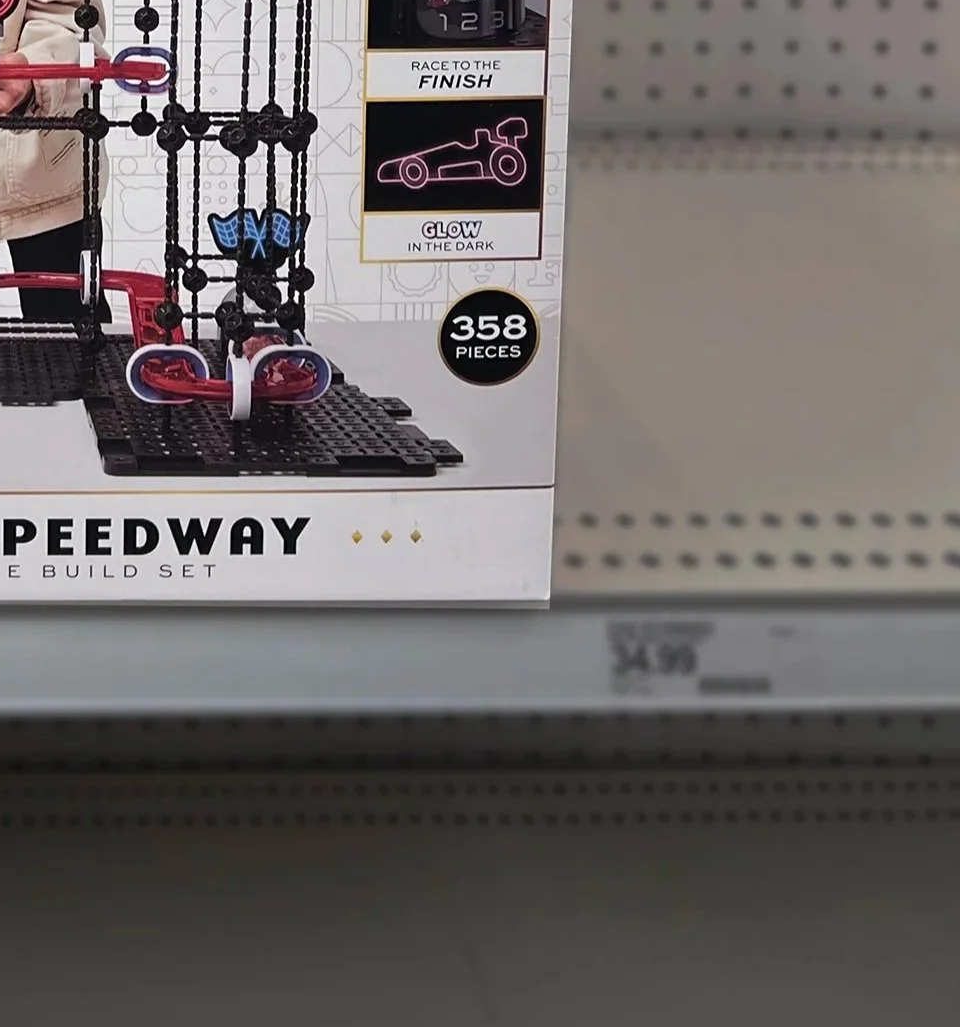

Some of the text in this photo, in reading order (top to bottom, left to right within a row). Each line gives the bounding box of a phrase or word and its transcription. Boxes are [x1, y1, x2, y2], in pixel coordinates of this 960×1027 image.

[439, 13, 448, 31] 1
[461, 12, 478, 31] 2
[411, 60, 501, 71] RACE TO THE
[418, 74, 493, 89] FINISH
[421, 220, 482, 239] GLOW
[408, 241, 494, 252] IN THE DARK
[450, 314, 527, 341] 358
[456, 345, 521, 359] PIECES
[42, 564, 139, 579] BUILD
[159, 564, 218, 579] SET
